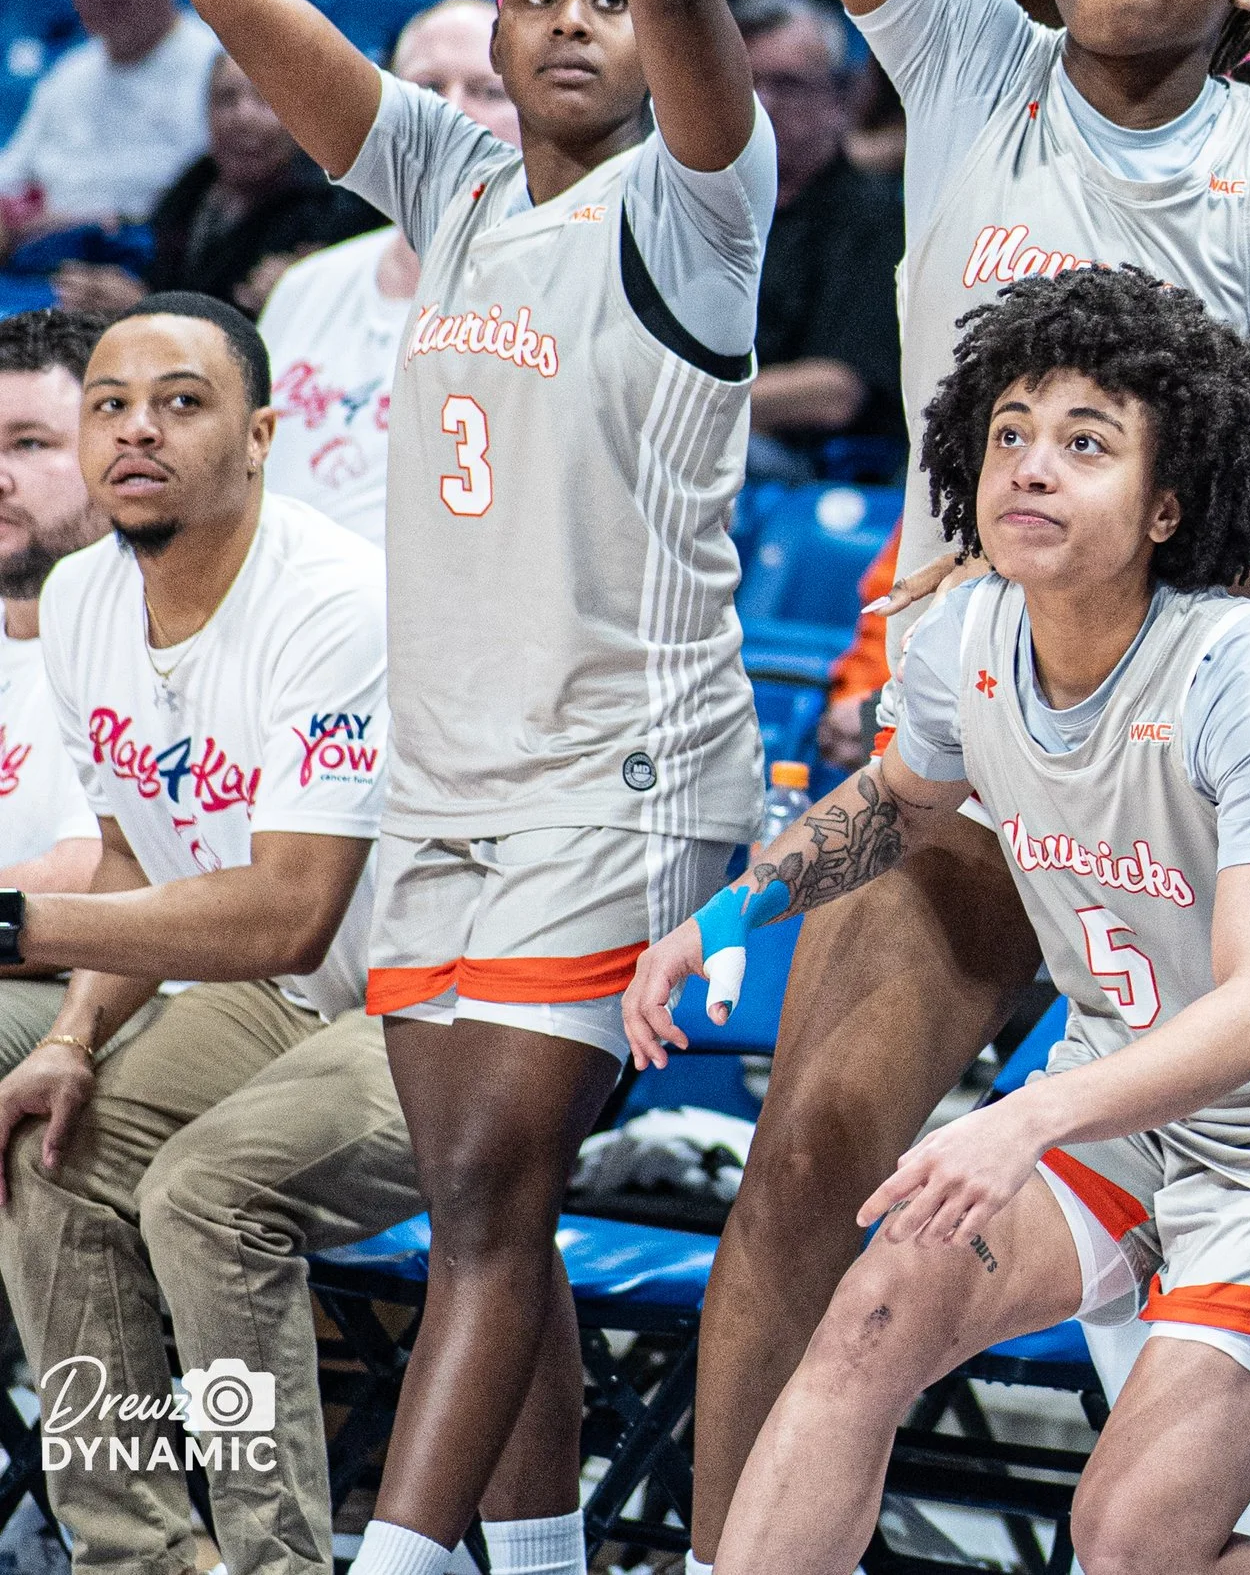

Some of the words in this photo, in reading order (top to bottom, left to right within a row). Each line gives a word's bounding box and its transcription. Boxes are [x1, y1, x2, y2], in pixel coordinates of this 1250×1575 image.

[440, 395, 493, 516] 3
[309, 713, 372, 740] KAY
[1130, 724, 1171, 741] WAC
[1074, 905, 1162, 1030] 5
